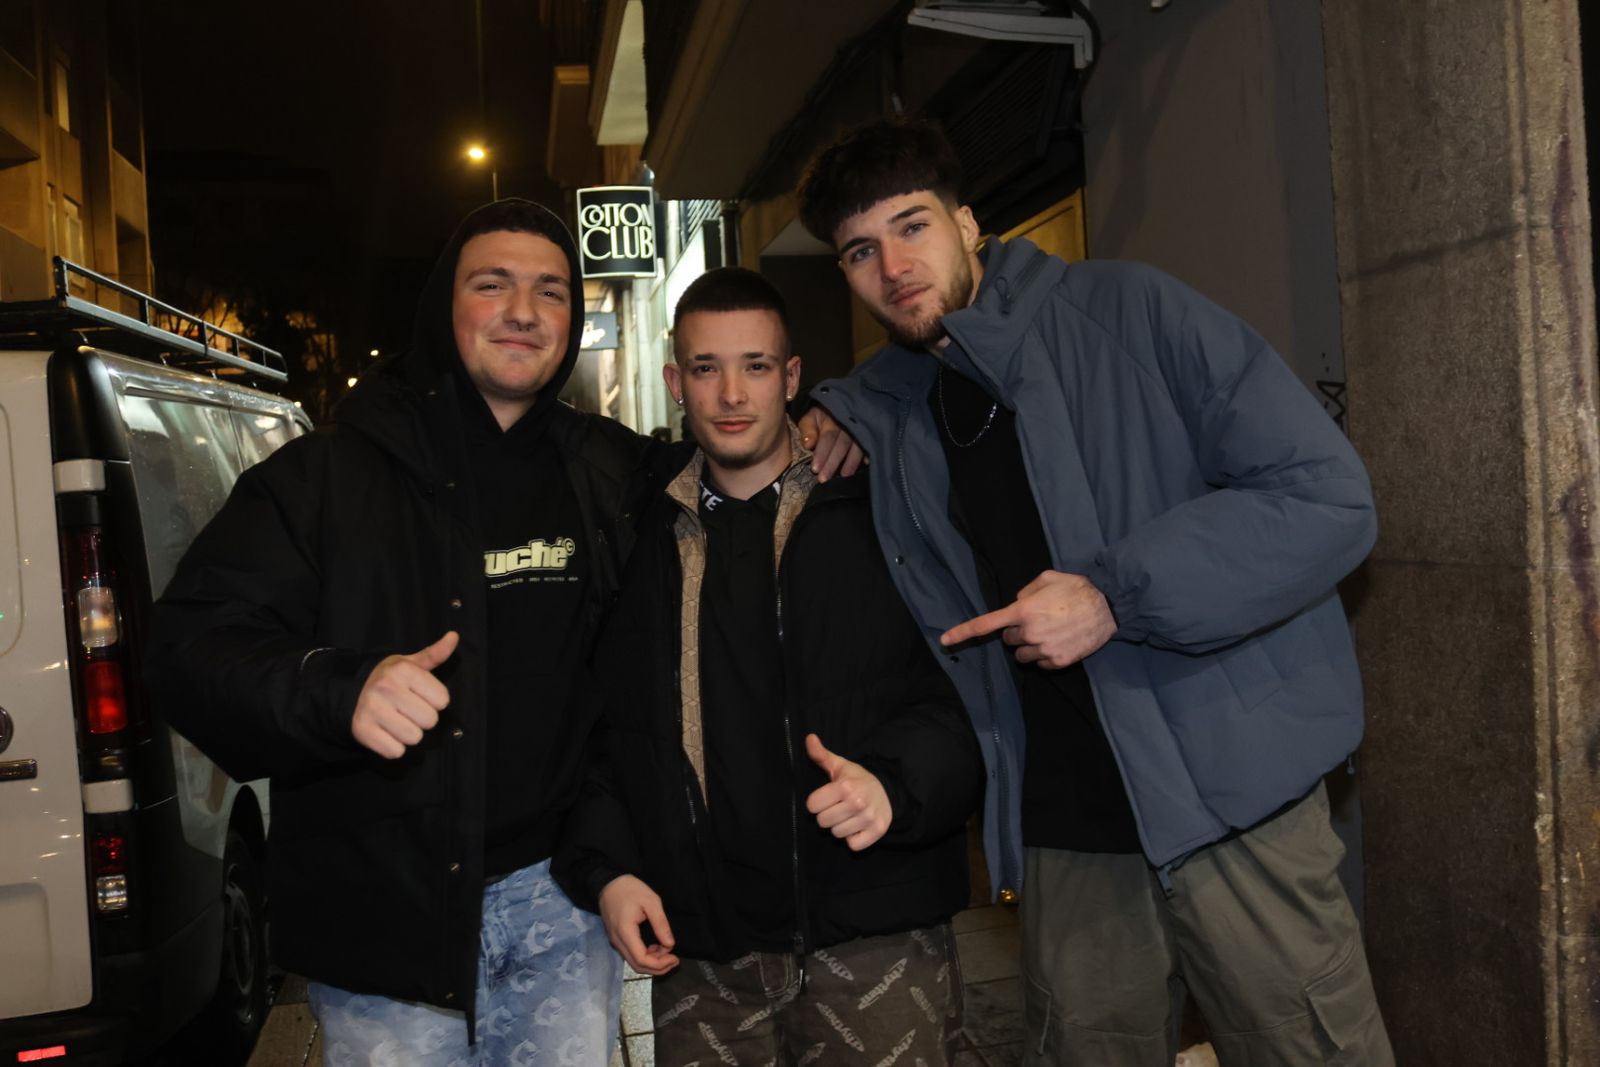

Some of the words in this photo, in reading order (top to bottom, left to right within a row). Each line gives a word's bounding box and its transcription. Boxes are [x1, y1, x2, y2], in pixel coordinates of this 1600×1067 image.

[580, 203, 652, 229] COTTON
[582, 226, 654, 260] CLUB
[700, 481, 724, 512] TE
